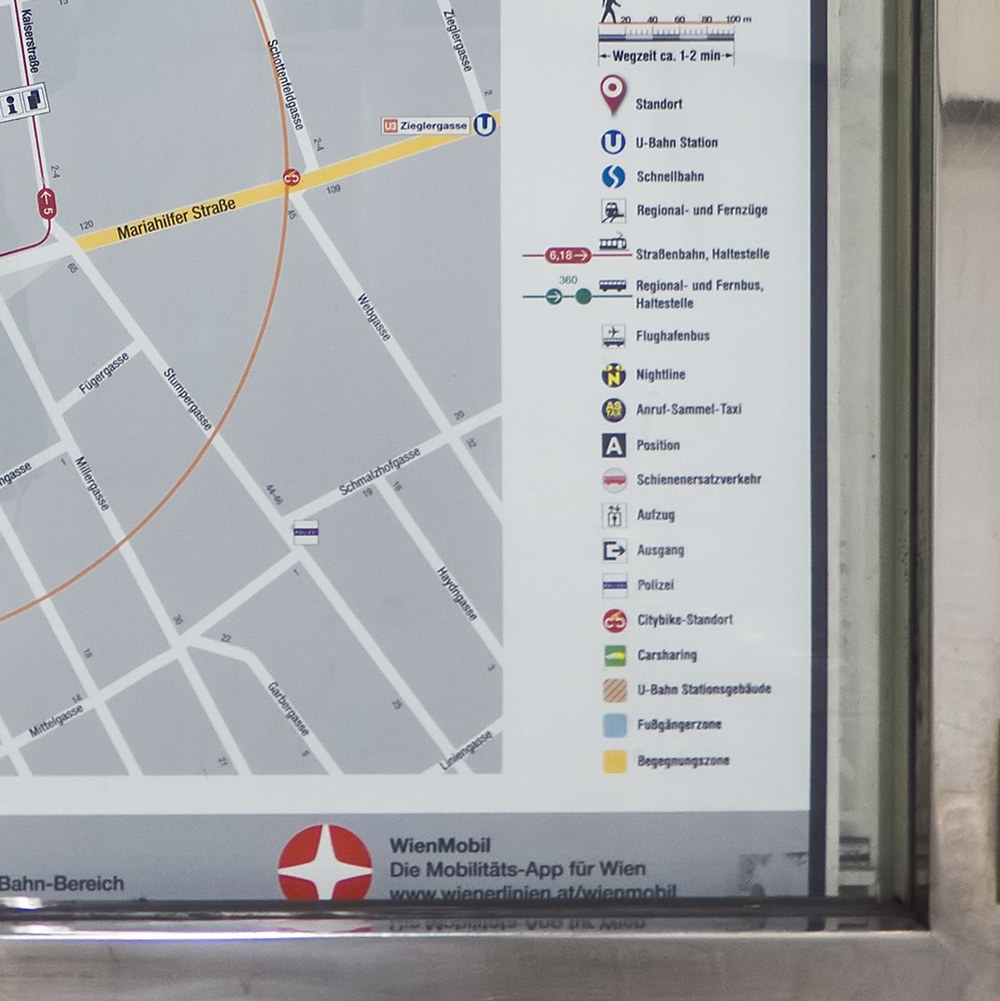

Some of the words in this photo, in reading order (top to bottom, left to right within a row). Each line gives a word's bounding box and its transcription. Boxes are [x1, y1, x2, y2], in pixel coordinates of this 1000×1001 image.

[21, 9, 39, 74] Kaiserstraße
[444, 9, 472, 72] Zieglergasse
[613, 50, 657, 64] Wegzeit
[660, 52, 676, 61] ca.
[680, 51, 696, 61] 1-2
[700, 50, 721, 61] min
[267, 39, 304, 131] Schottenfeldgasse
[636, 99, 683, 110] Standort
[385, 121, 398, 131] U3
[400, 120, 468, 133] Zieglergasse
[636, 138, 676, 148] U-Bahn
[680, 137, 718, 148] Station
[637, 171, 704, 182] Schnellbahn
[637, 204, 689, 218] Regional-
[694, 205, 713, 215] und
[717, 204, 768, 217] Fernzüge
[79, 220, 94, 231] 120
[117, 208, 188, 240] Mariahilfer
[192, 198, 236, 220] Straße
[550, 251, 572, 261] 6,18
[636, 249, 709, 262] Straßenbahn,
[712, 249, 770, 260] Haltestelle
[559, 276, 578, 284] 360
[636, 280, 688, 294] Regional-
[692, 280, 712, 291] und
[716, 280, 764, 293] Fernbus,
[636, 298, 694, 309] Haltestelle
[357, 293, 391, 342] Webgasse
[636, 330, 710, 343] Flughafenbus
[79, 351, 130, 395] Fügergasse
[636, 369, 686, 382] Nightline
[163, 367, 213, 432] Stumpergasse
[636, 404, 742, 416] Anruf-Sammel-Taxi
[637, 440, 680, 451] Position
[339, 447, 421, 496] Schmalzhofgasse
[75, 456, 109, 512] Millergasse
[637, 474, 762, 486] Schienenersatzverkehr
[637, 510, 675, 522] Aufzug
[637, 546, 684, 558] Ausgang
[638, 580, 674, 591] Polizei
[437, 566, 478, 622] Haydngasse
[638, 614, 733, 628] Citybike-Standort
[638, 650, 697, 662] Carsharing
[638, 684, 678, 695] U-Bahn
[682, 683, 772, 696] Stationsgebäude
[267, 681, 310, 737] Garbergasse
[28, 704, 84, 739] Mittelgasse
[638, 718, 722, 732] Fußgängerzone
[638, 755, 730, 768] Begegnungszone
[390, 838, 491, 854] WienMobil
[390, 862, 421, 878] Die
[426, 861, 563, 880] Mobilitäts-App
[569, 861, 595, 877] für
[599, 861, 646, 877] Wien
